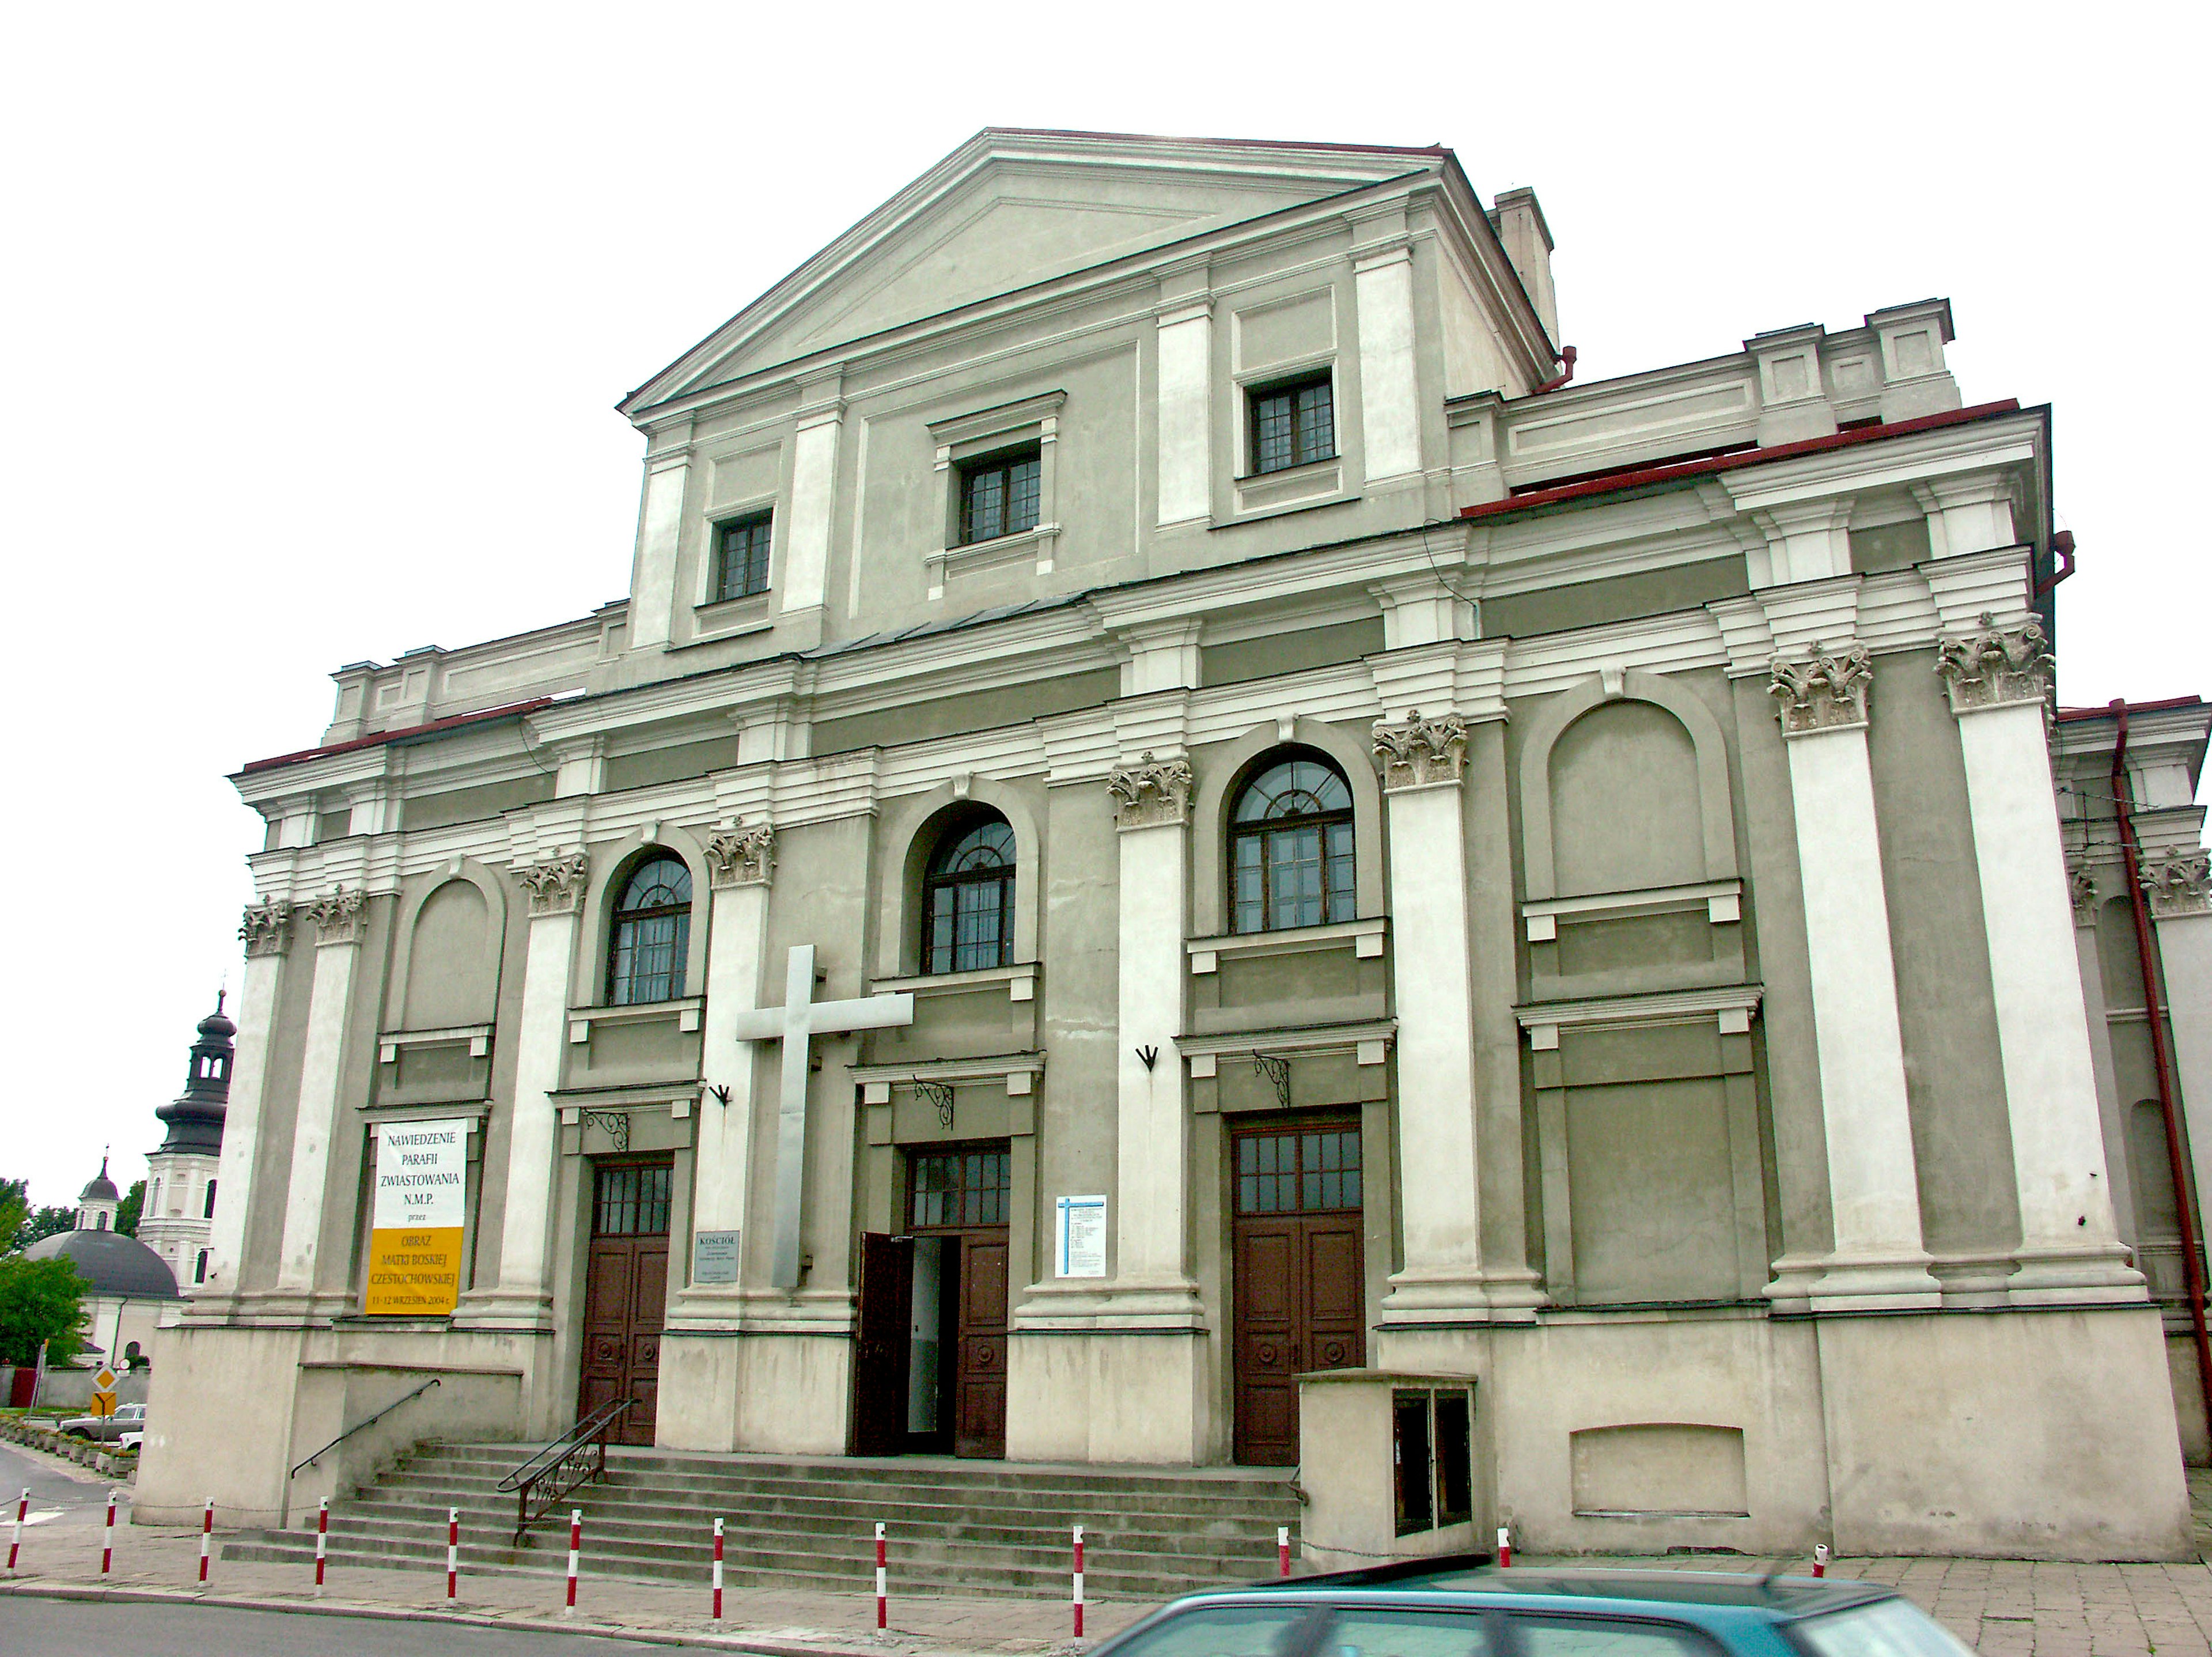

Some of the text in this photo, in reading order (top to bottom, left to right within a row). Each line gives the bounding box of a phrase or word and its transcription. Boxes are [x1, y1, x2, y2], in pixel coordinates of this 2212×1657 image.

[388, 1132, 456, 1146] NAWIEDZENIE
[402, 1153, 438, 1165] PARAFII
[381, 1173, 460, 1187] ZWIASTOWANIA
[404, 1193, 434, 1205] N.M.P.
[408, 1214, 426, 1222] przez
[401, 1235, 432, 1247] OBRAZ
[700, 1235, 735, 1245] KOŚCIÓŁ
[382, 1253, 448, 1267] MATKI BOSKIEJ
[428, 1296, 445, 1305] 2004
